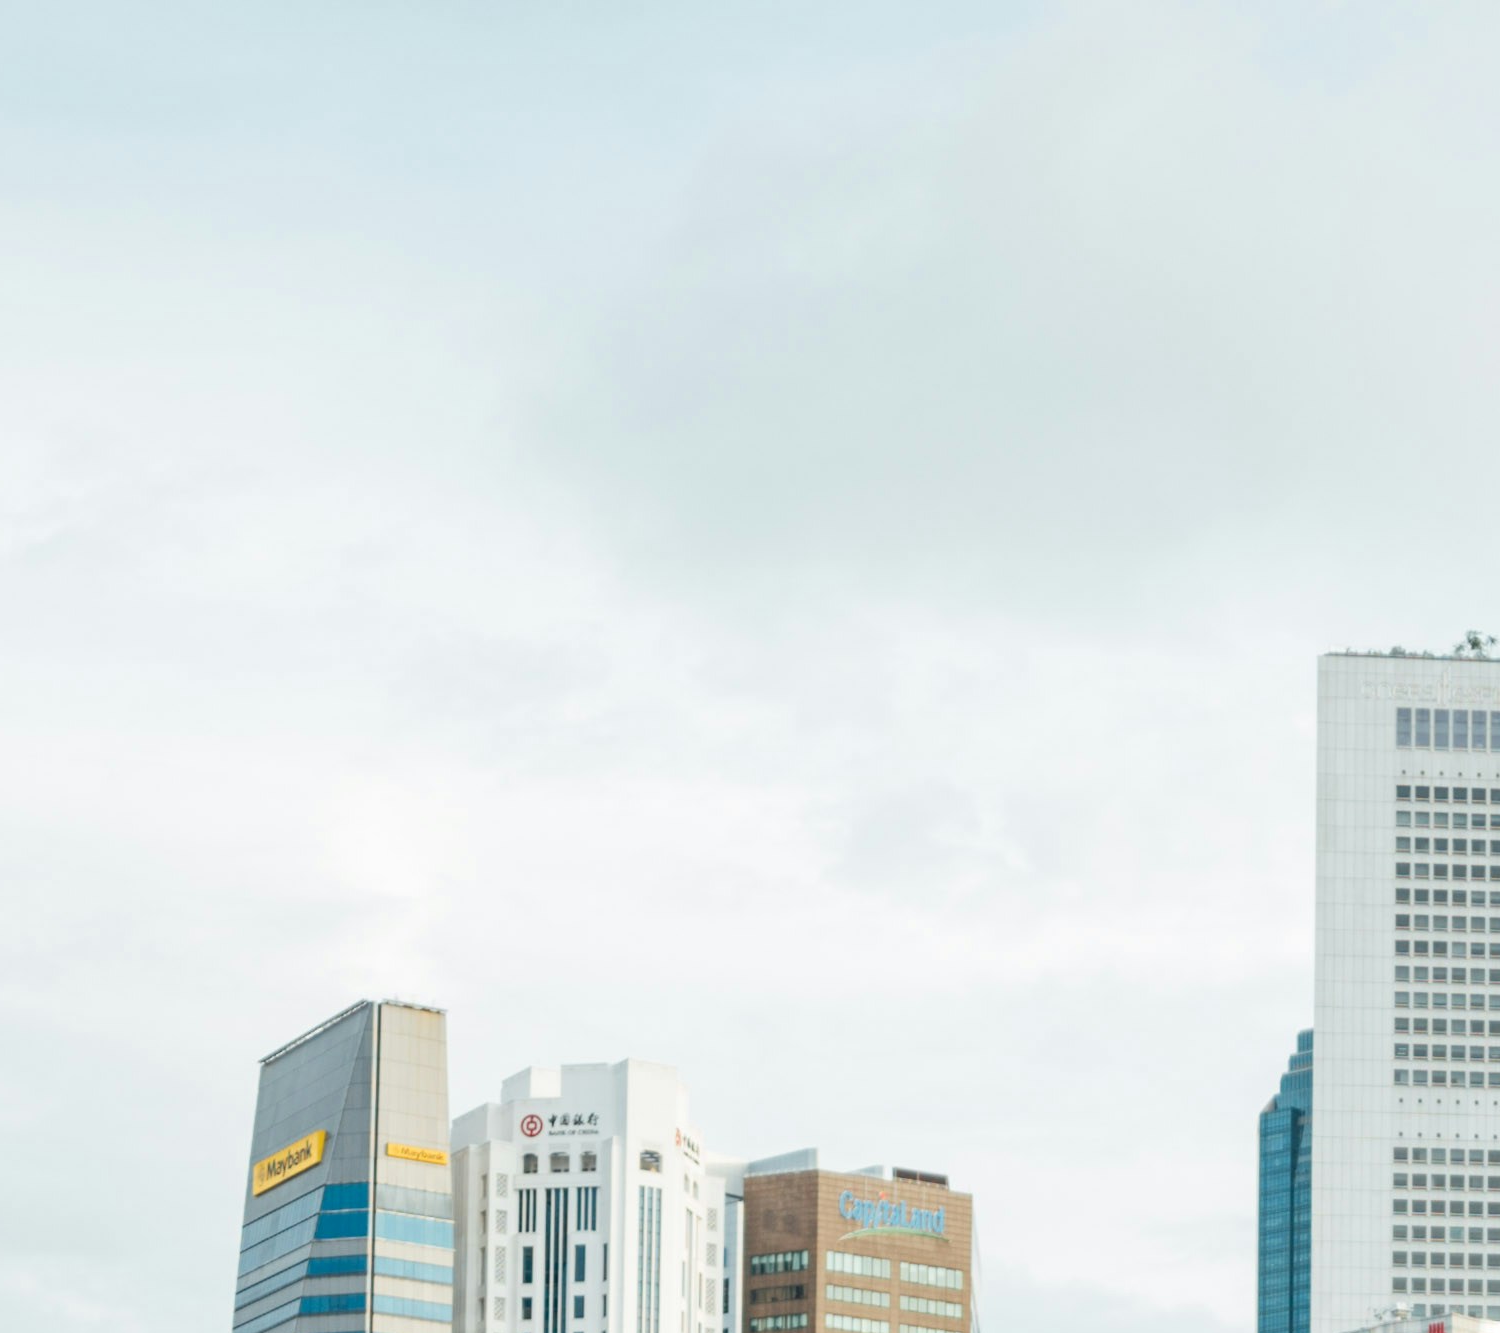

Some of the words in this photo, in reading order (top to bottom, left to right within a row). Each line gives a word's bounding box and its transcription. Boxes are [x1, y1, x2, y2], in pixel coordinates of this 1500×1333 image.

[266, 1140, 312, 1181] Maybank
[400, 1147, 444, 1161] Maybank
[839, 1190, 946, 1233] CapitaLand
